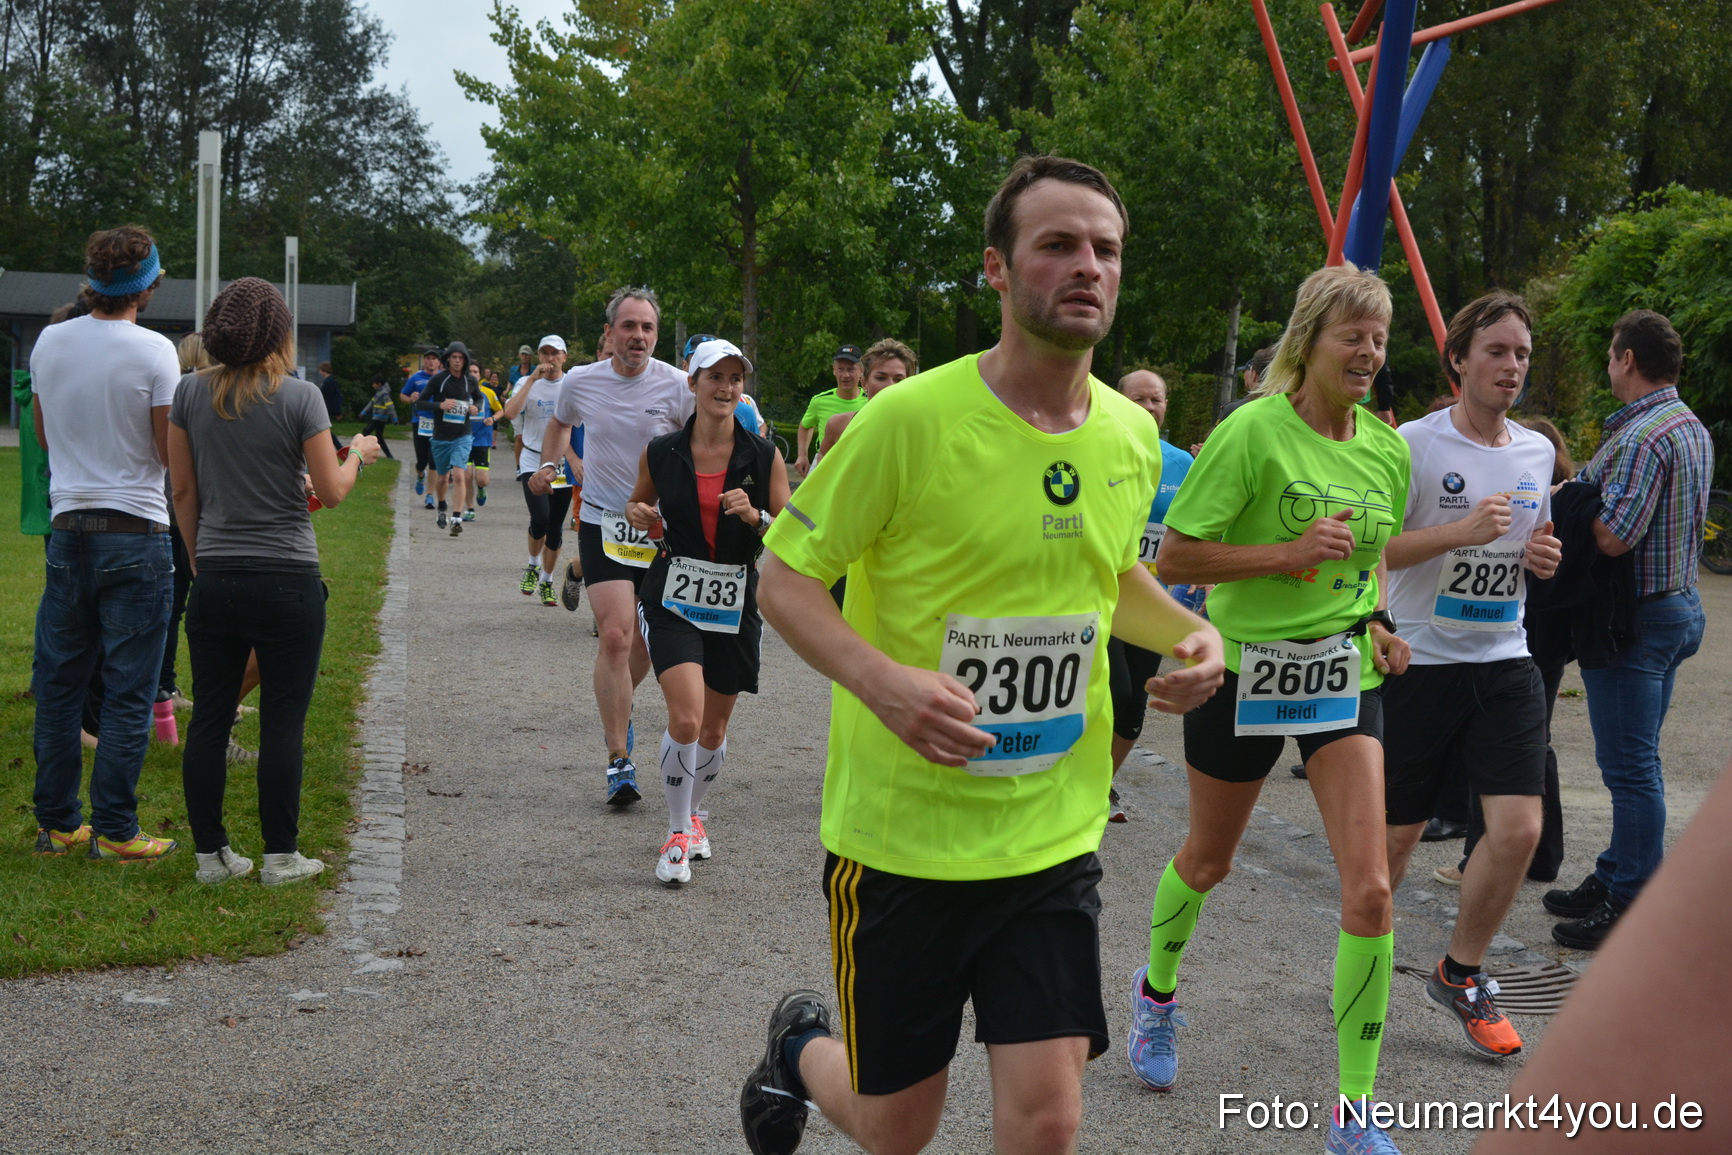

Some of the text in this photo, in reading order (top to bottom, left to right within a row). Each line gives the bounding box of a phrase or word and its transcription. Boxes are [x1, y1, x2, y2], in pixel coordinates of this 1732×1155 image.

[1046, 463, 1077, 478] BMW
[1439, 496, 1470, 504] PARTL
[1042, 512, 1083, 531] Partl
[1043, 530, 1083, 540] Neumarkt
[1139, 536, 1160, 560] 01
[1449, 549, 1519, 560] PARTL Neumarkt
[672, 563, 734, 578] PARTL Neumarkt
[1448, 562, 1520, 597] 2823
[672, 573, 738, 607] 2133
[683, 607, 720, 622] Kerstin
[1460, 604, 1505, 620] Manuel
[948, 630, 1076, 649] PARTL Neumarkt
[1244, 643, 1340, 662] PARTL Neumarkt
[956, 653, 1080, 715] 2300
[1250, 656, 1350, 696] 2605
[1276, 704, 1318, 720] Heidi
[987, 731, 1041, 755] Peter
